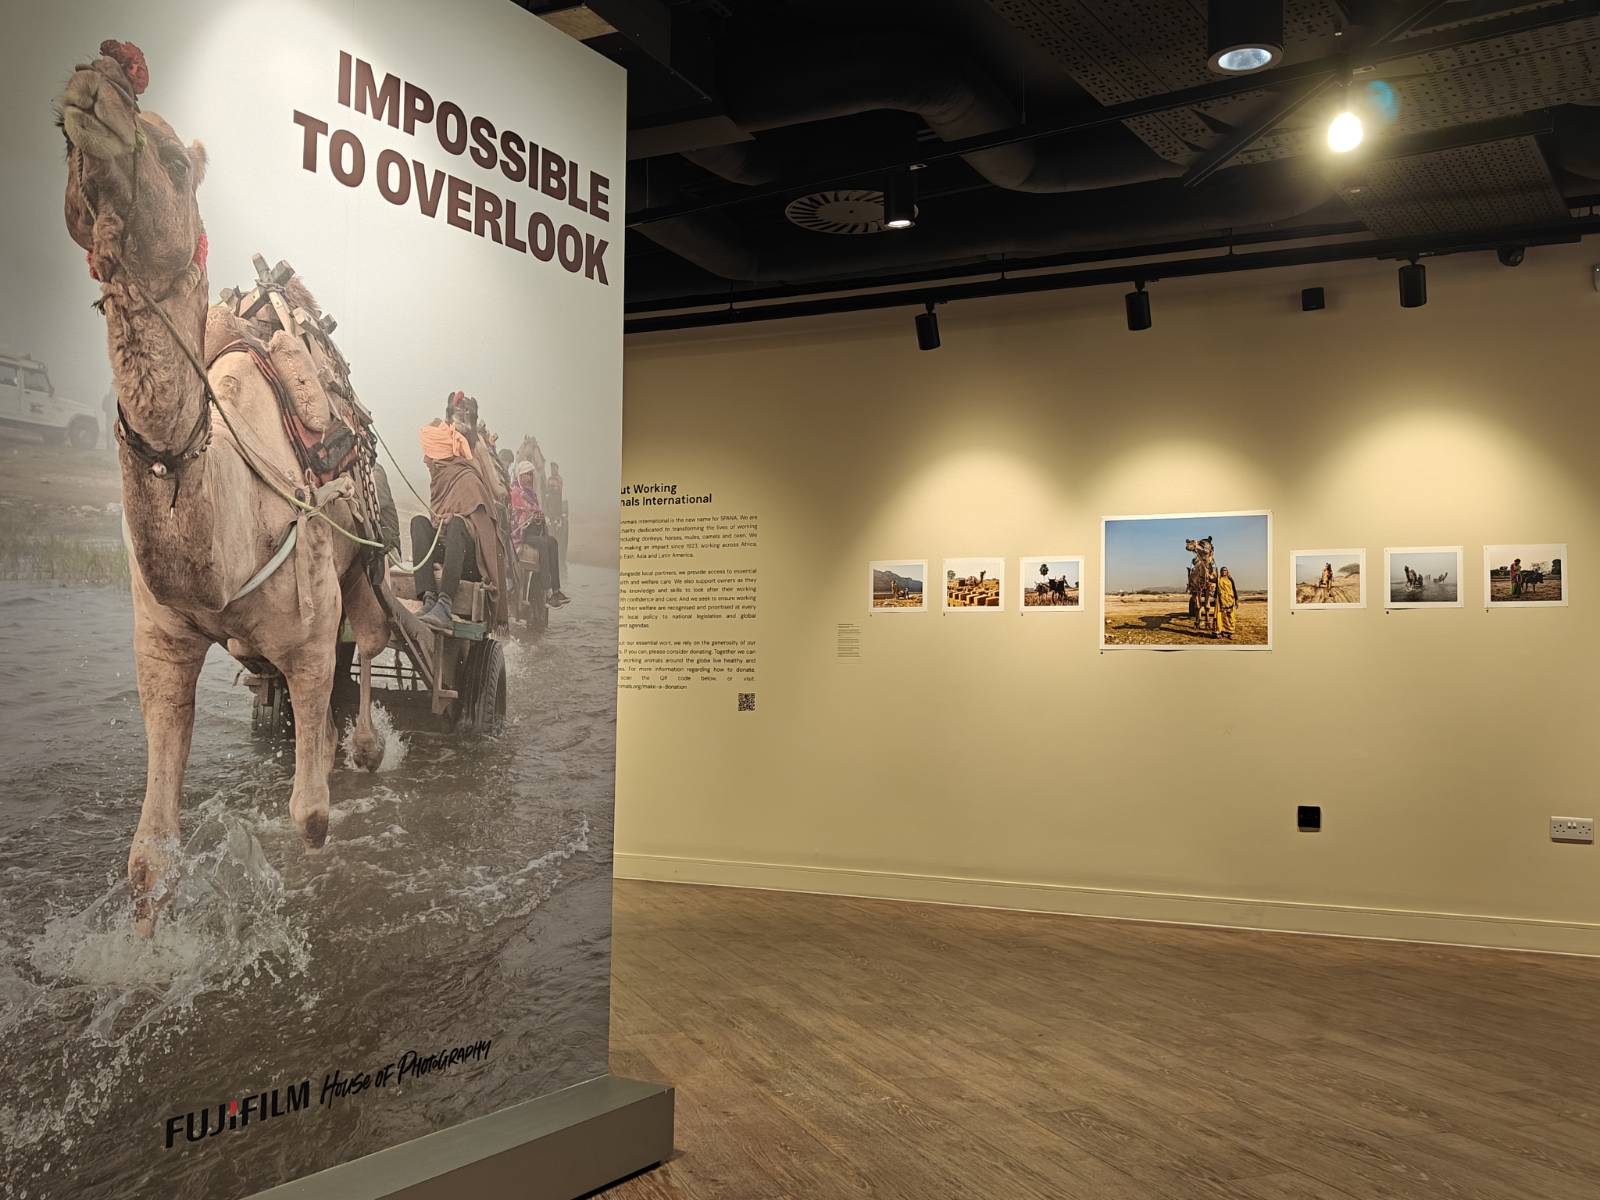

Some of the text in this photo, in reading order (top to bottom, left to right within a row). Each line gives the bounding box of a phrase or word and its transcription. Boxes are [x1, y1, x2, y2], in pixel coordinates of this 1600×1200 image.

[337, 49, 610, 222] IMPOSSIBLE
[293, 109, 609, 286] TO OVERLOOK
[633, 483, 677, 495] Working
[642, 493, 712, 506] International
[164, 1079, 310, 1149] FUJIFILM
